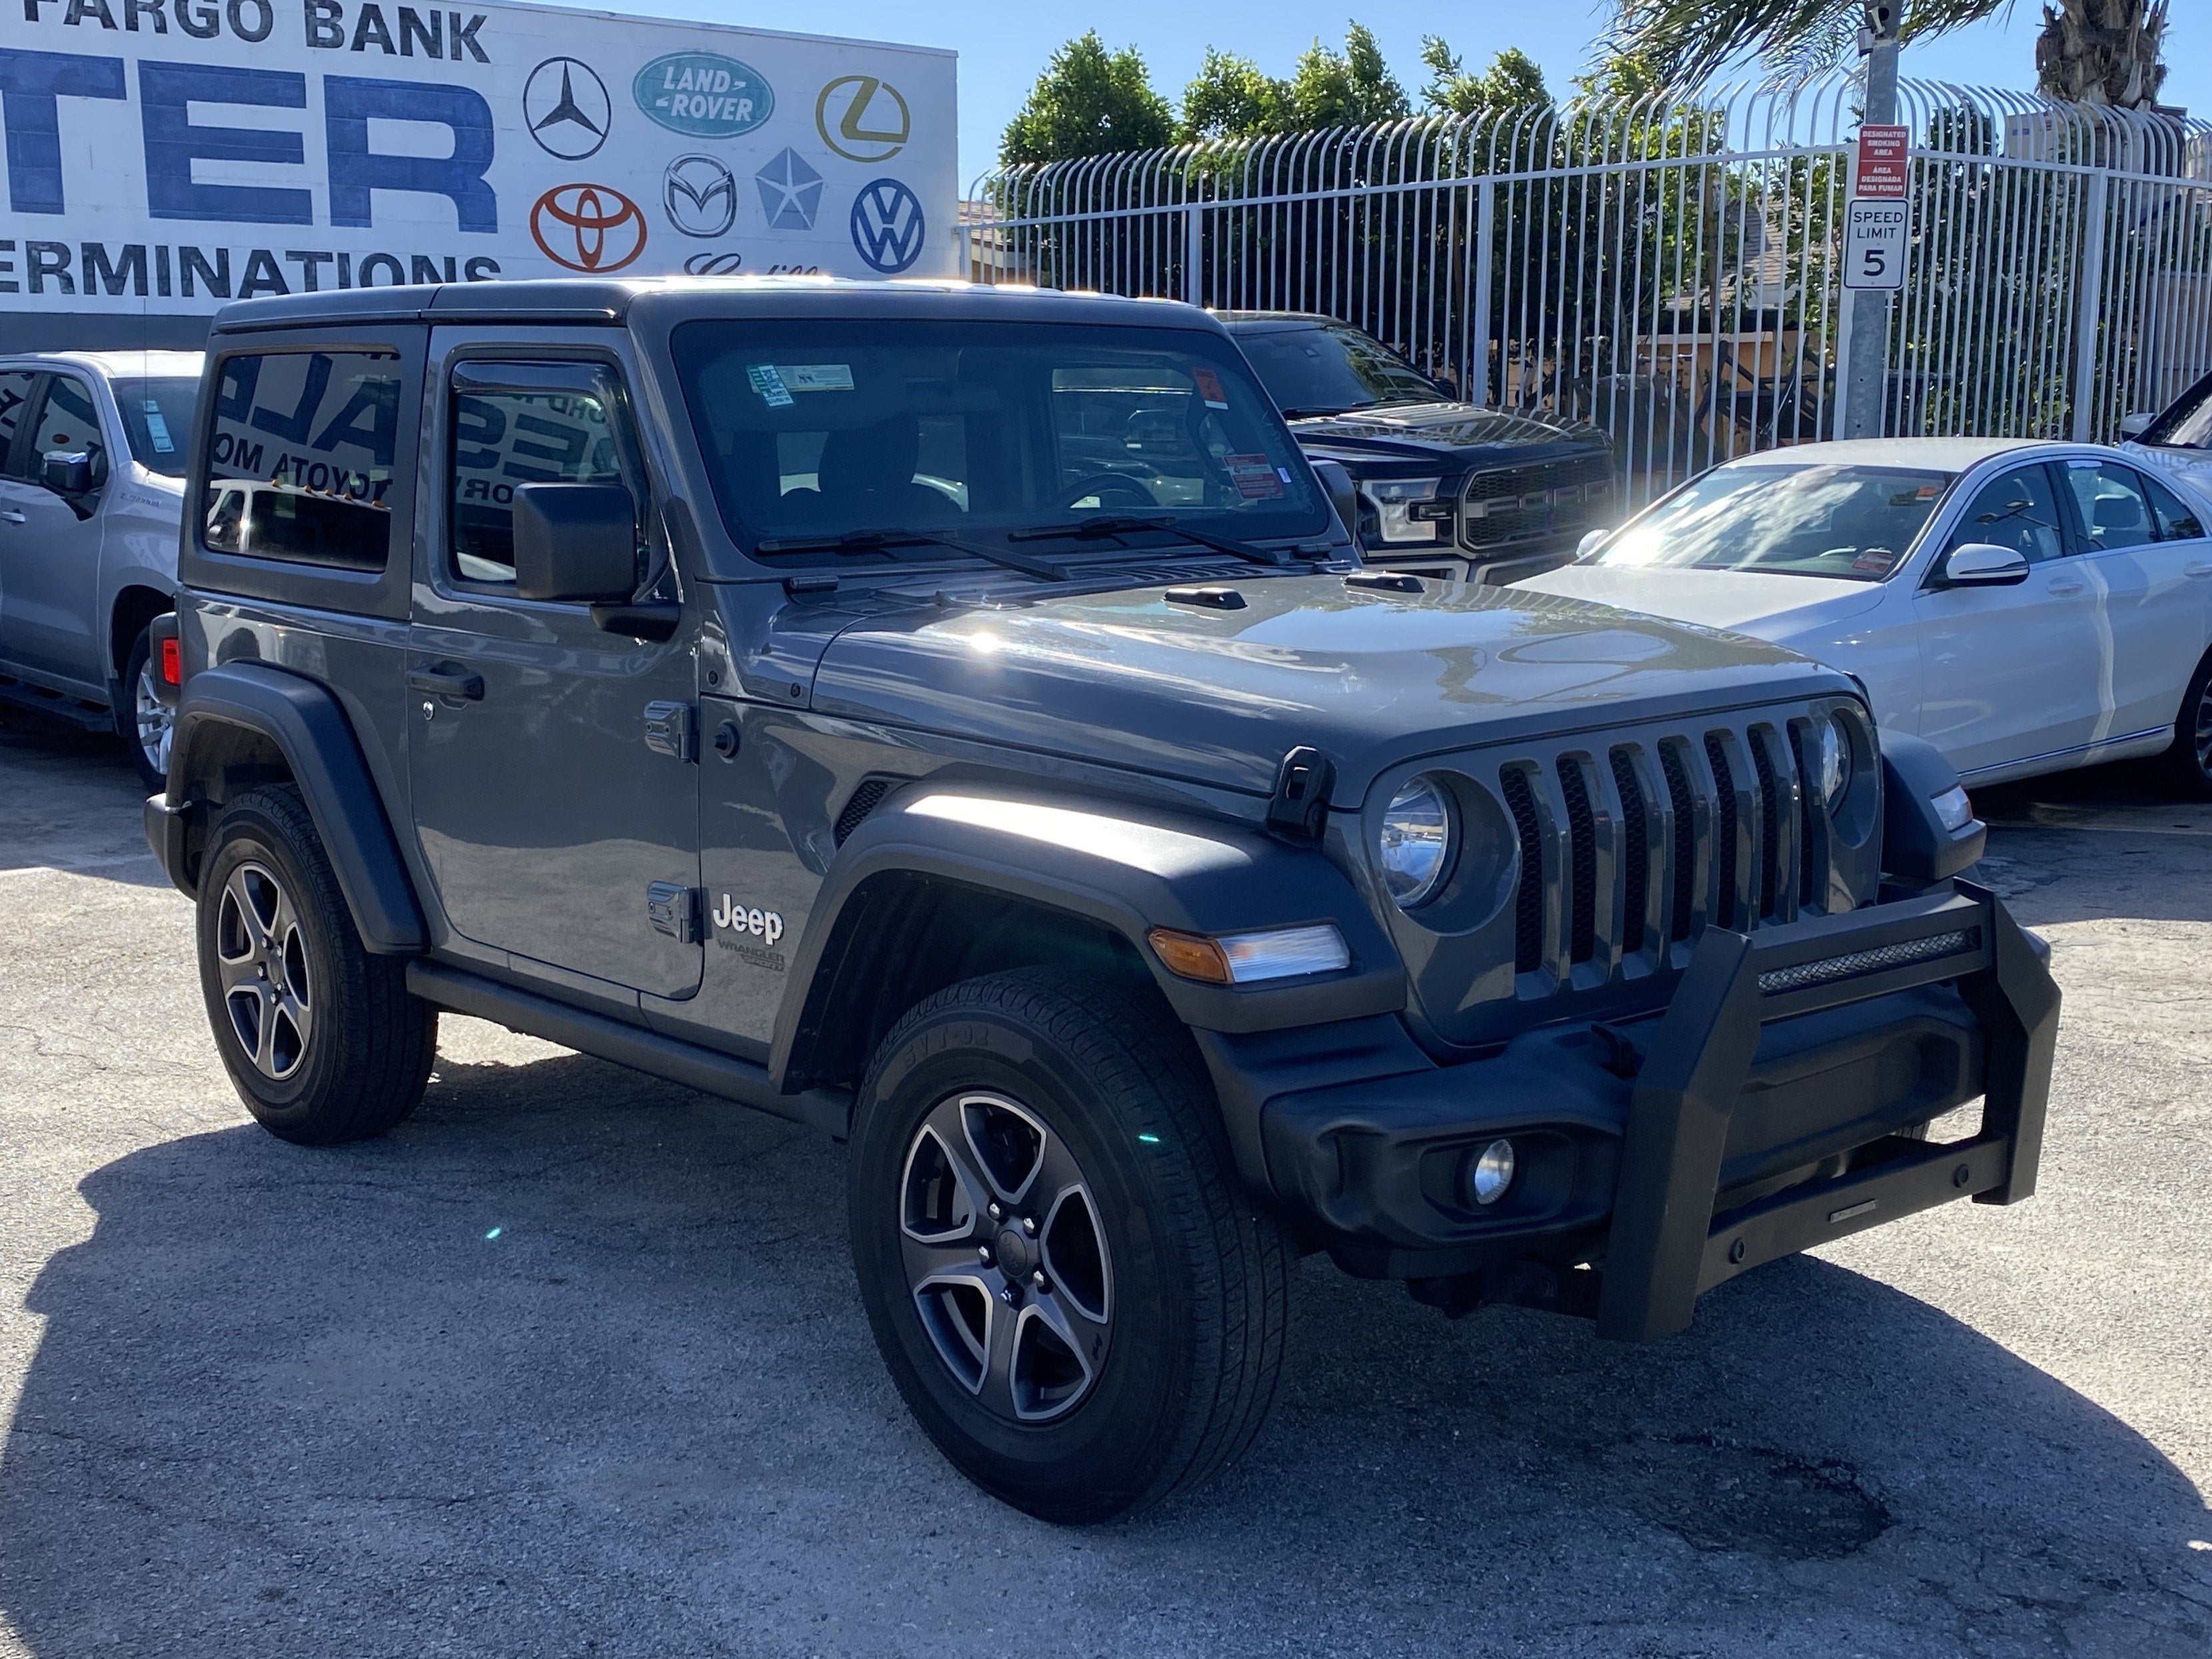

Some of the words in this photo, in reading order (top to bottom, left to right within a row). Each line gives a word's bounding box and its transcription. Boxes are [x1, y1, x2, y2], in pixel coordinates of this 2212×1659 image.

[305, 0, 491, 63] BANK
[664, 67, 731, 93] LAND
[671, 94, 753, 121] ROVER
[0, 47, 498, 234] TER
[1853, 212, 1903, 223] SPEED
[1857, 227, 1897, 239] LIMIT
[1863, 249, 1885, 276] 5
[712, 892, 784, 946] Jeep
[717, 938, 785, 965] WRANGLER
